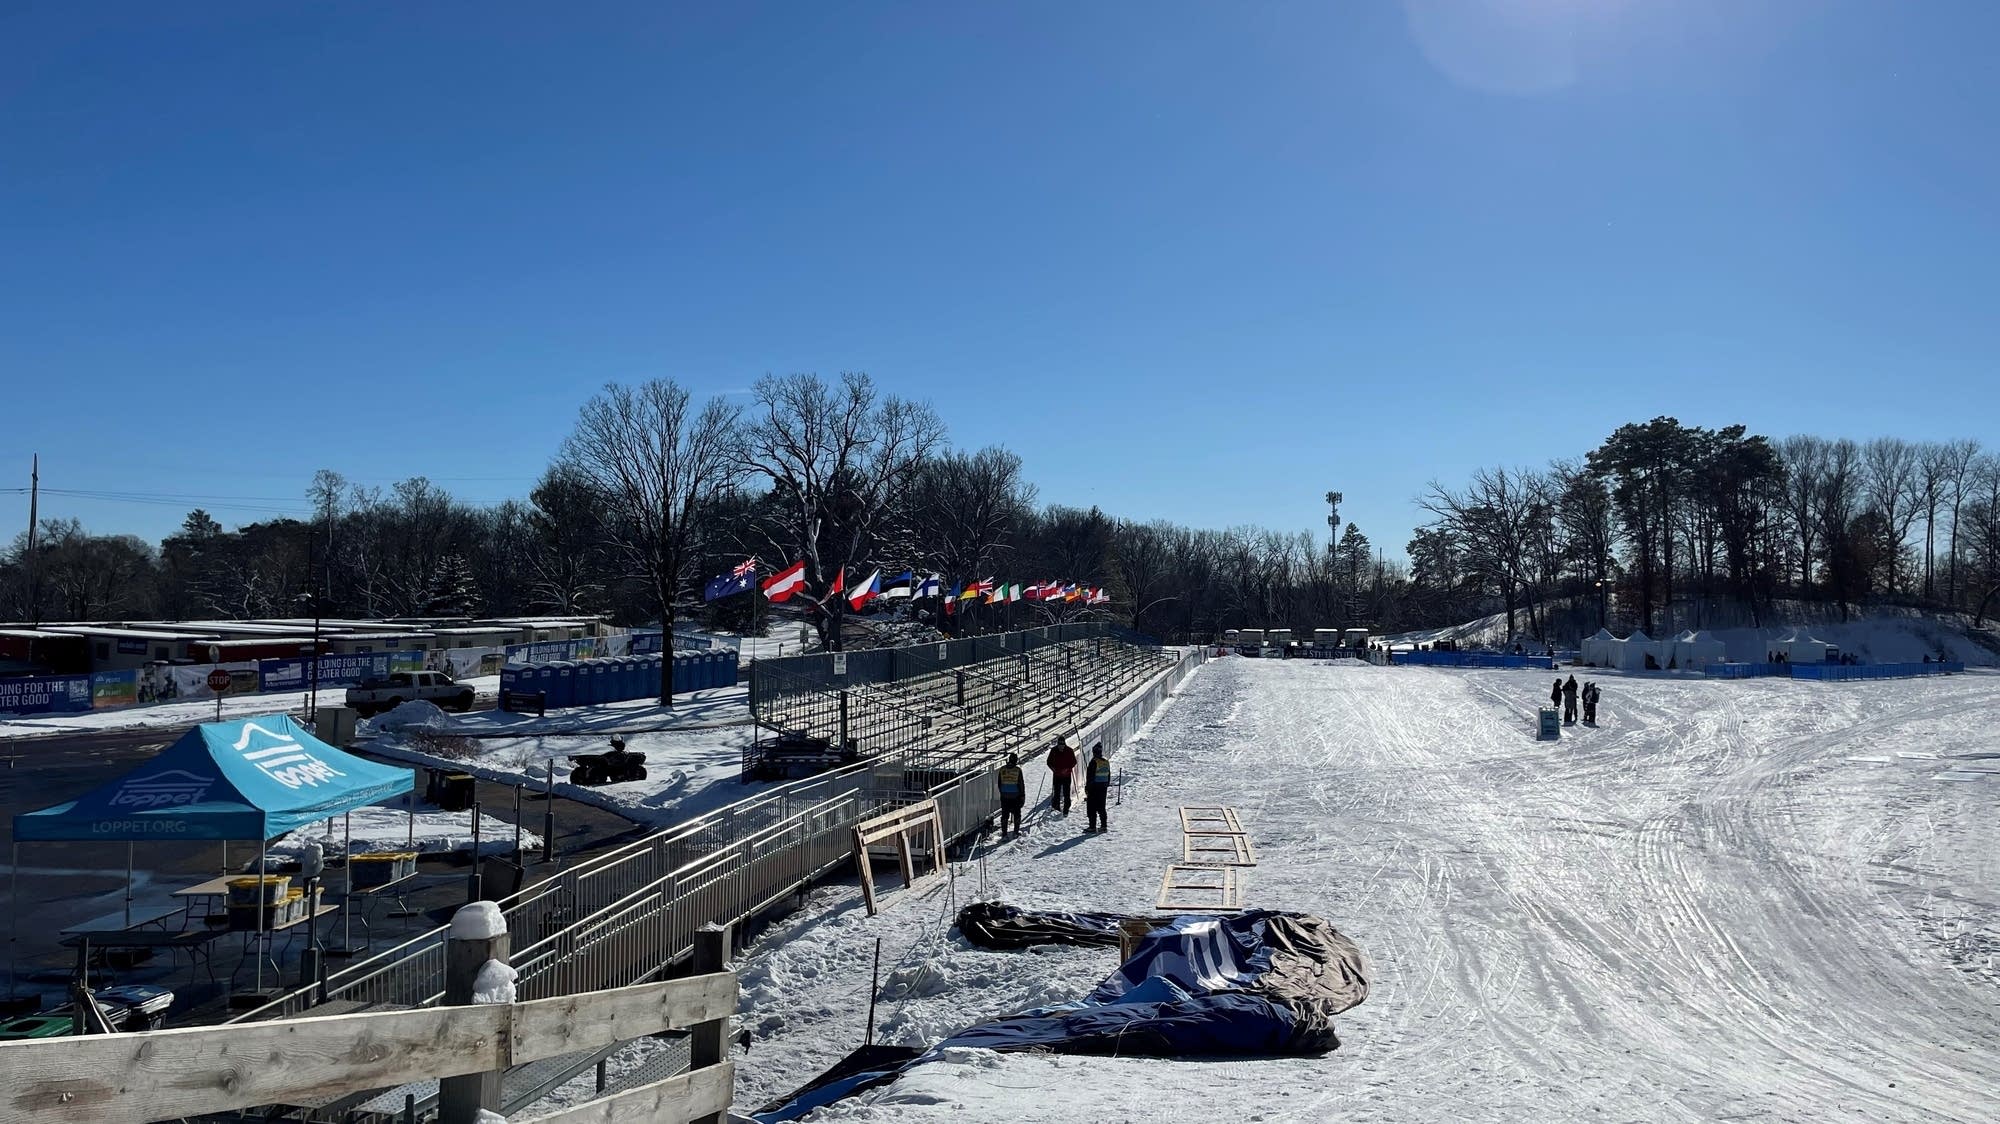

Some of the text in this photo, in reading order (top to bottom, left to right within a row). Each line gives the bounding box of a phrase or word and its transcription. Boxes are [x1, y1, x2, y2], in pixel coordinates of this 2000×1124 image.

[307, 657, 371, 670] BILDING FOR THE
[208, 675, 230, 685] STOP
[307, 667, 361, 680] GEATER GOOD
[24, 682, 44, 694] FOR
[46, 681, 64, 692] THE
[0, 693, 50, 707] TER GOOD
[92, 820, 188, 833] LOPPET.ORG
